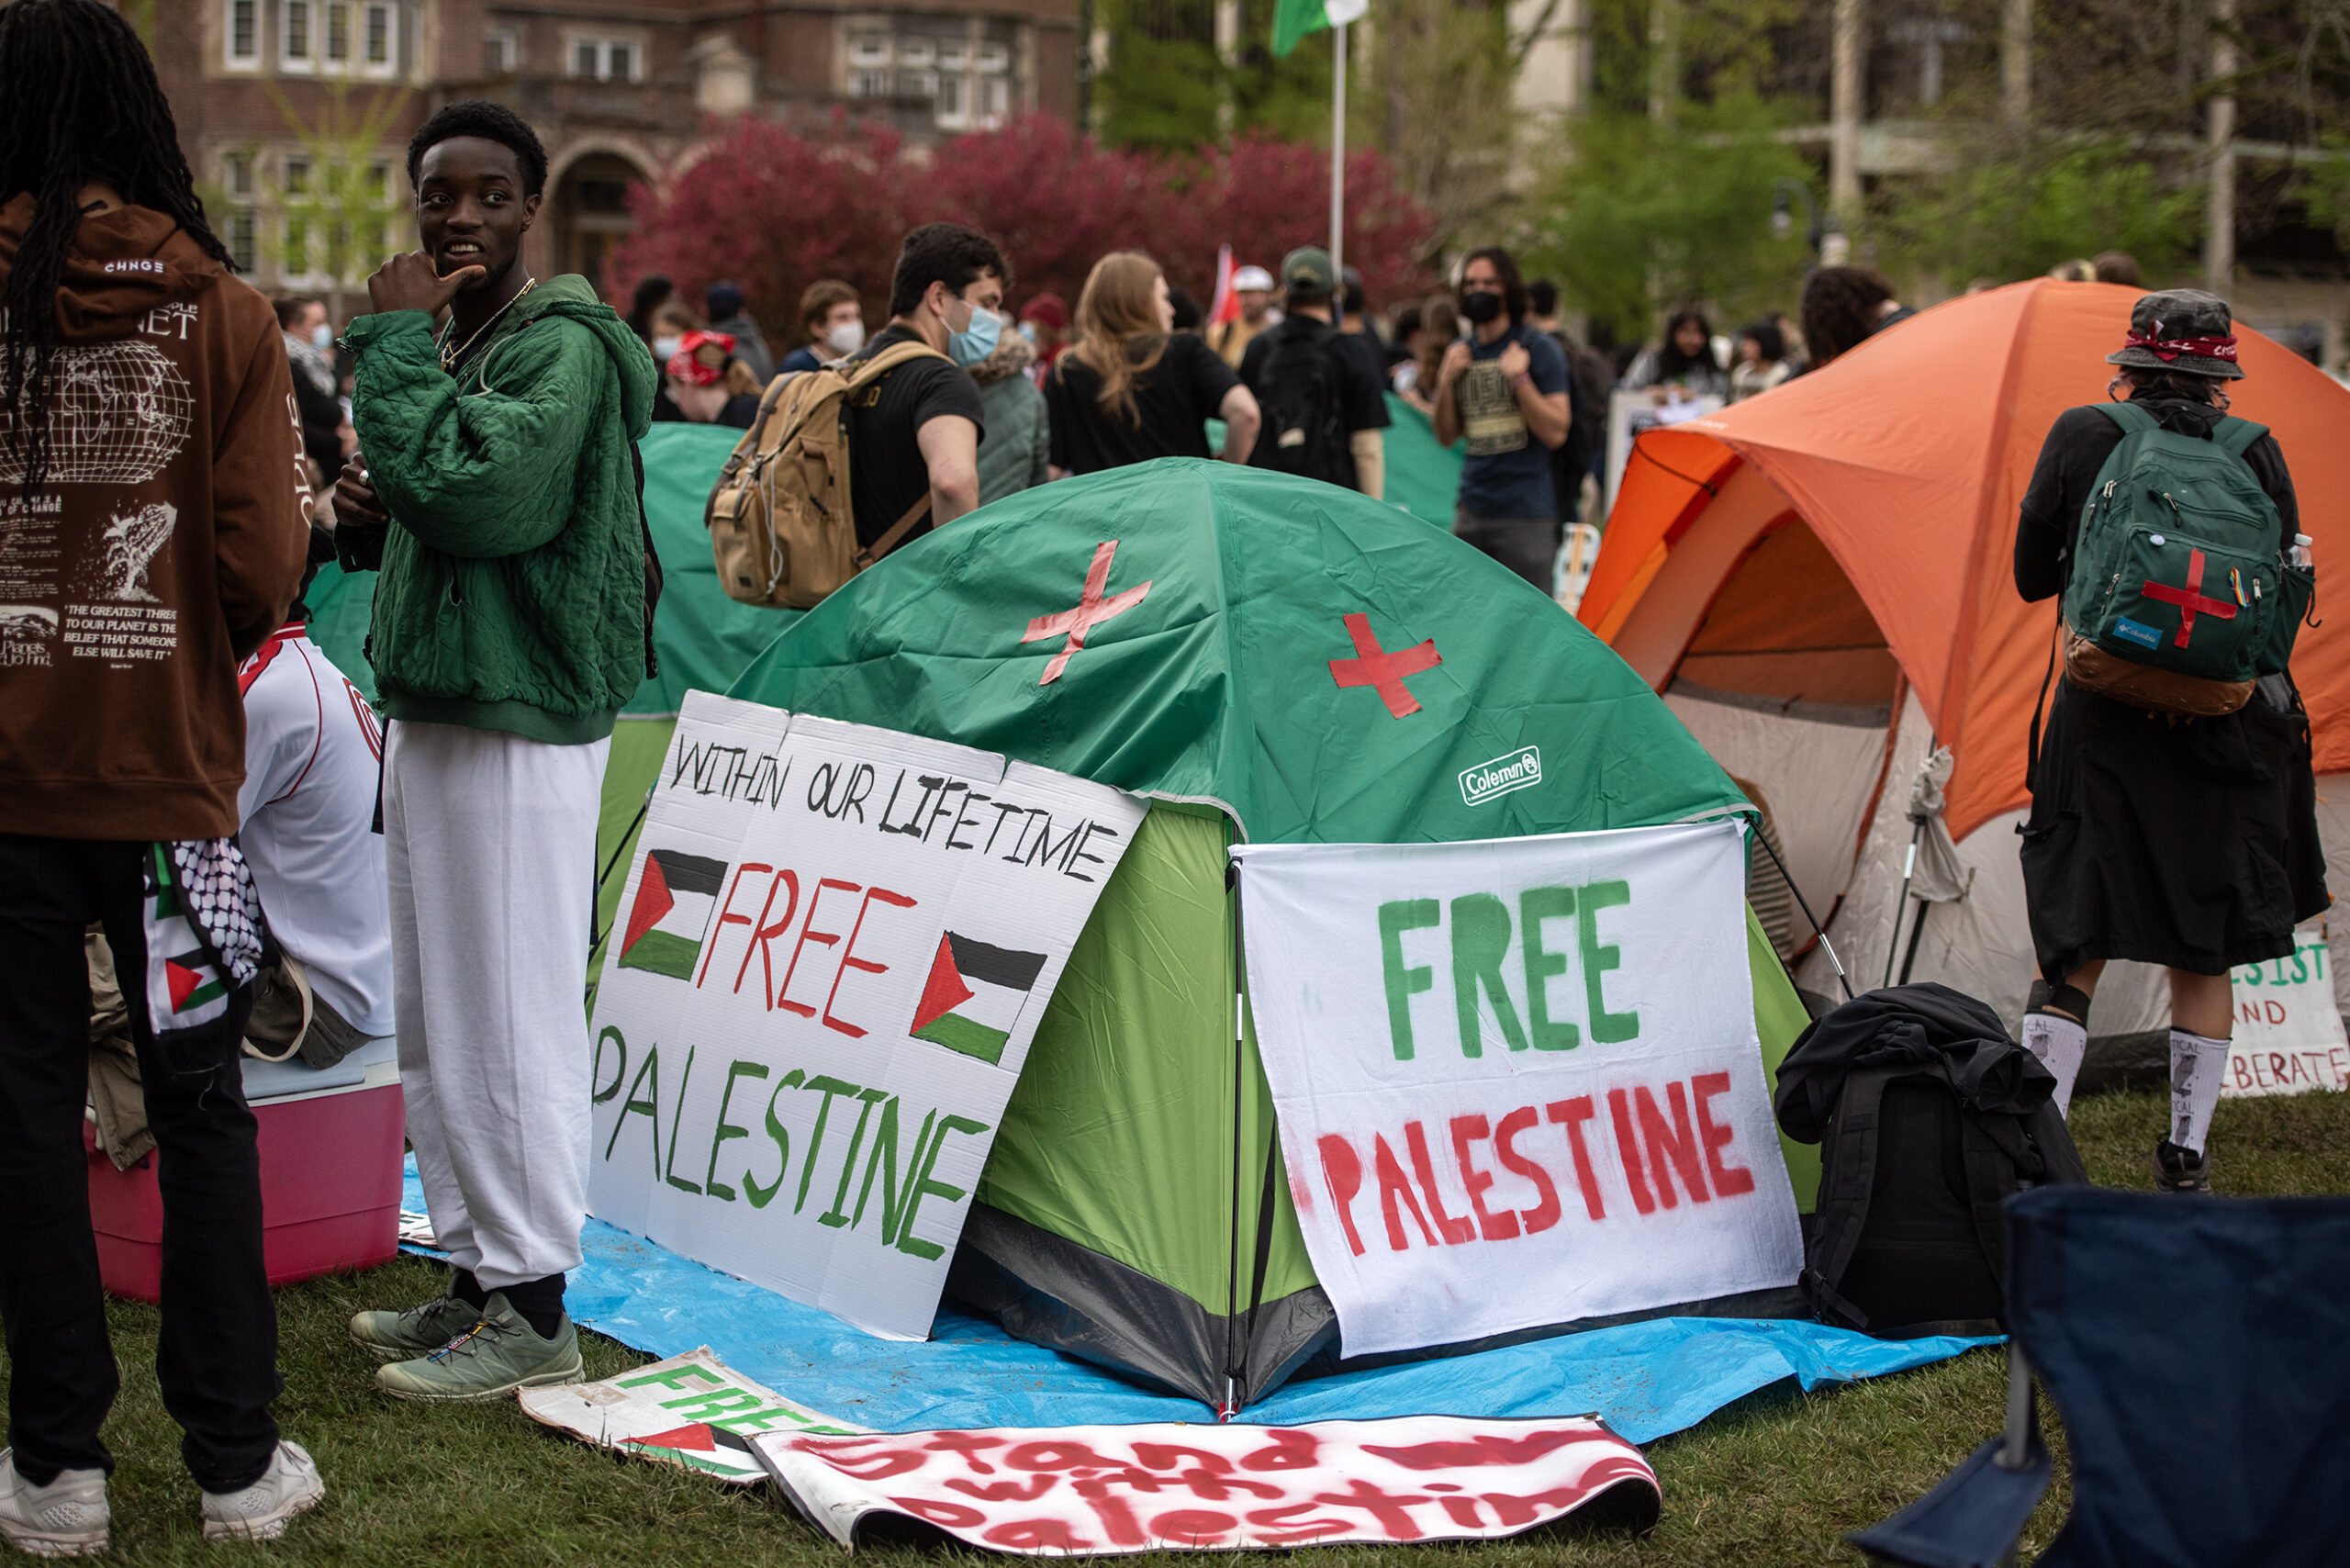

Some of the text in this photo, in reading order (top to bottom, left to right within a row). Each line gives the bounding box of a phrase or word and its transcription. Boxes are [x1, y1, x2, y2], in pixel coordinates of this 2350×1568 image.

[105, 261, 163, 274] CHNGE
[66, 619, 177, 633] TO OUR PLANET IS THE
[90, 606, 144, 617] GREATEST
[63, 633, 177, 647] BELIEF THAT SOMEONE
[73, 646, 99, 657] ELSE
[101, 648, 126, 658] WILL
[127, 648, 154, 659] SAVE
[1466, 762, 1524, 795] Coleman
[671, 735, 1122, 892] WITHIN OUR LIFETIME
[698, 863, 918, 1039] FREE
[2232, 944, 2329, 987] SIST
[1378, 879, 1640, 1062] FREE
[2232, 1000, 2287, 1026] ND
[2221, 1047, 2349, 1090] BERATE
[592, 1025, 991, 1262] PALESTINE
[1317, 1071, 1754, 1257] PALESTINE
